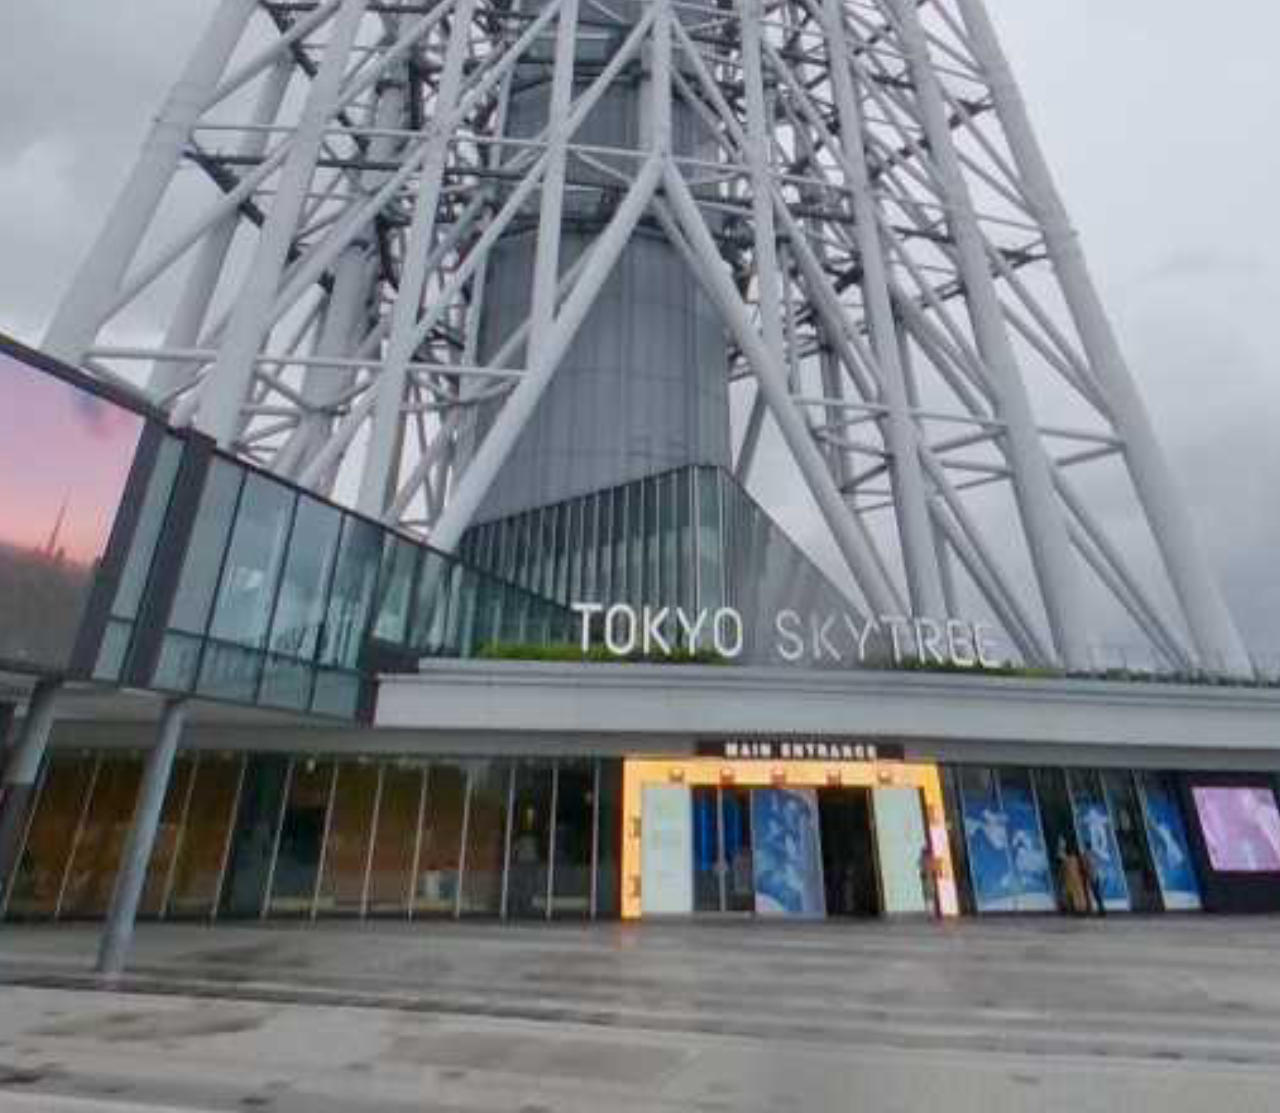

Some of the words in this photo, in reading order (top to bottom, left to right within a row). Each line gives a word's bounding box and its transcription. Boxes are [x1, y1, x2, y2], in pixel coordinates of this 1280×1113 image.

[571, 602, 743, 658] TOKYO
[775, 608, 1002, 668] SKYTREE
[724, 742, 771, 757] MAIN
[780, 742, 878, 759] ENTRANCE
